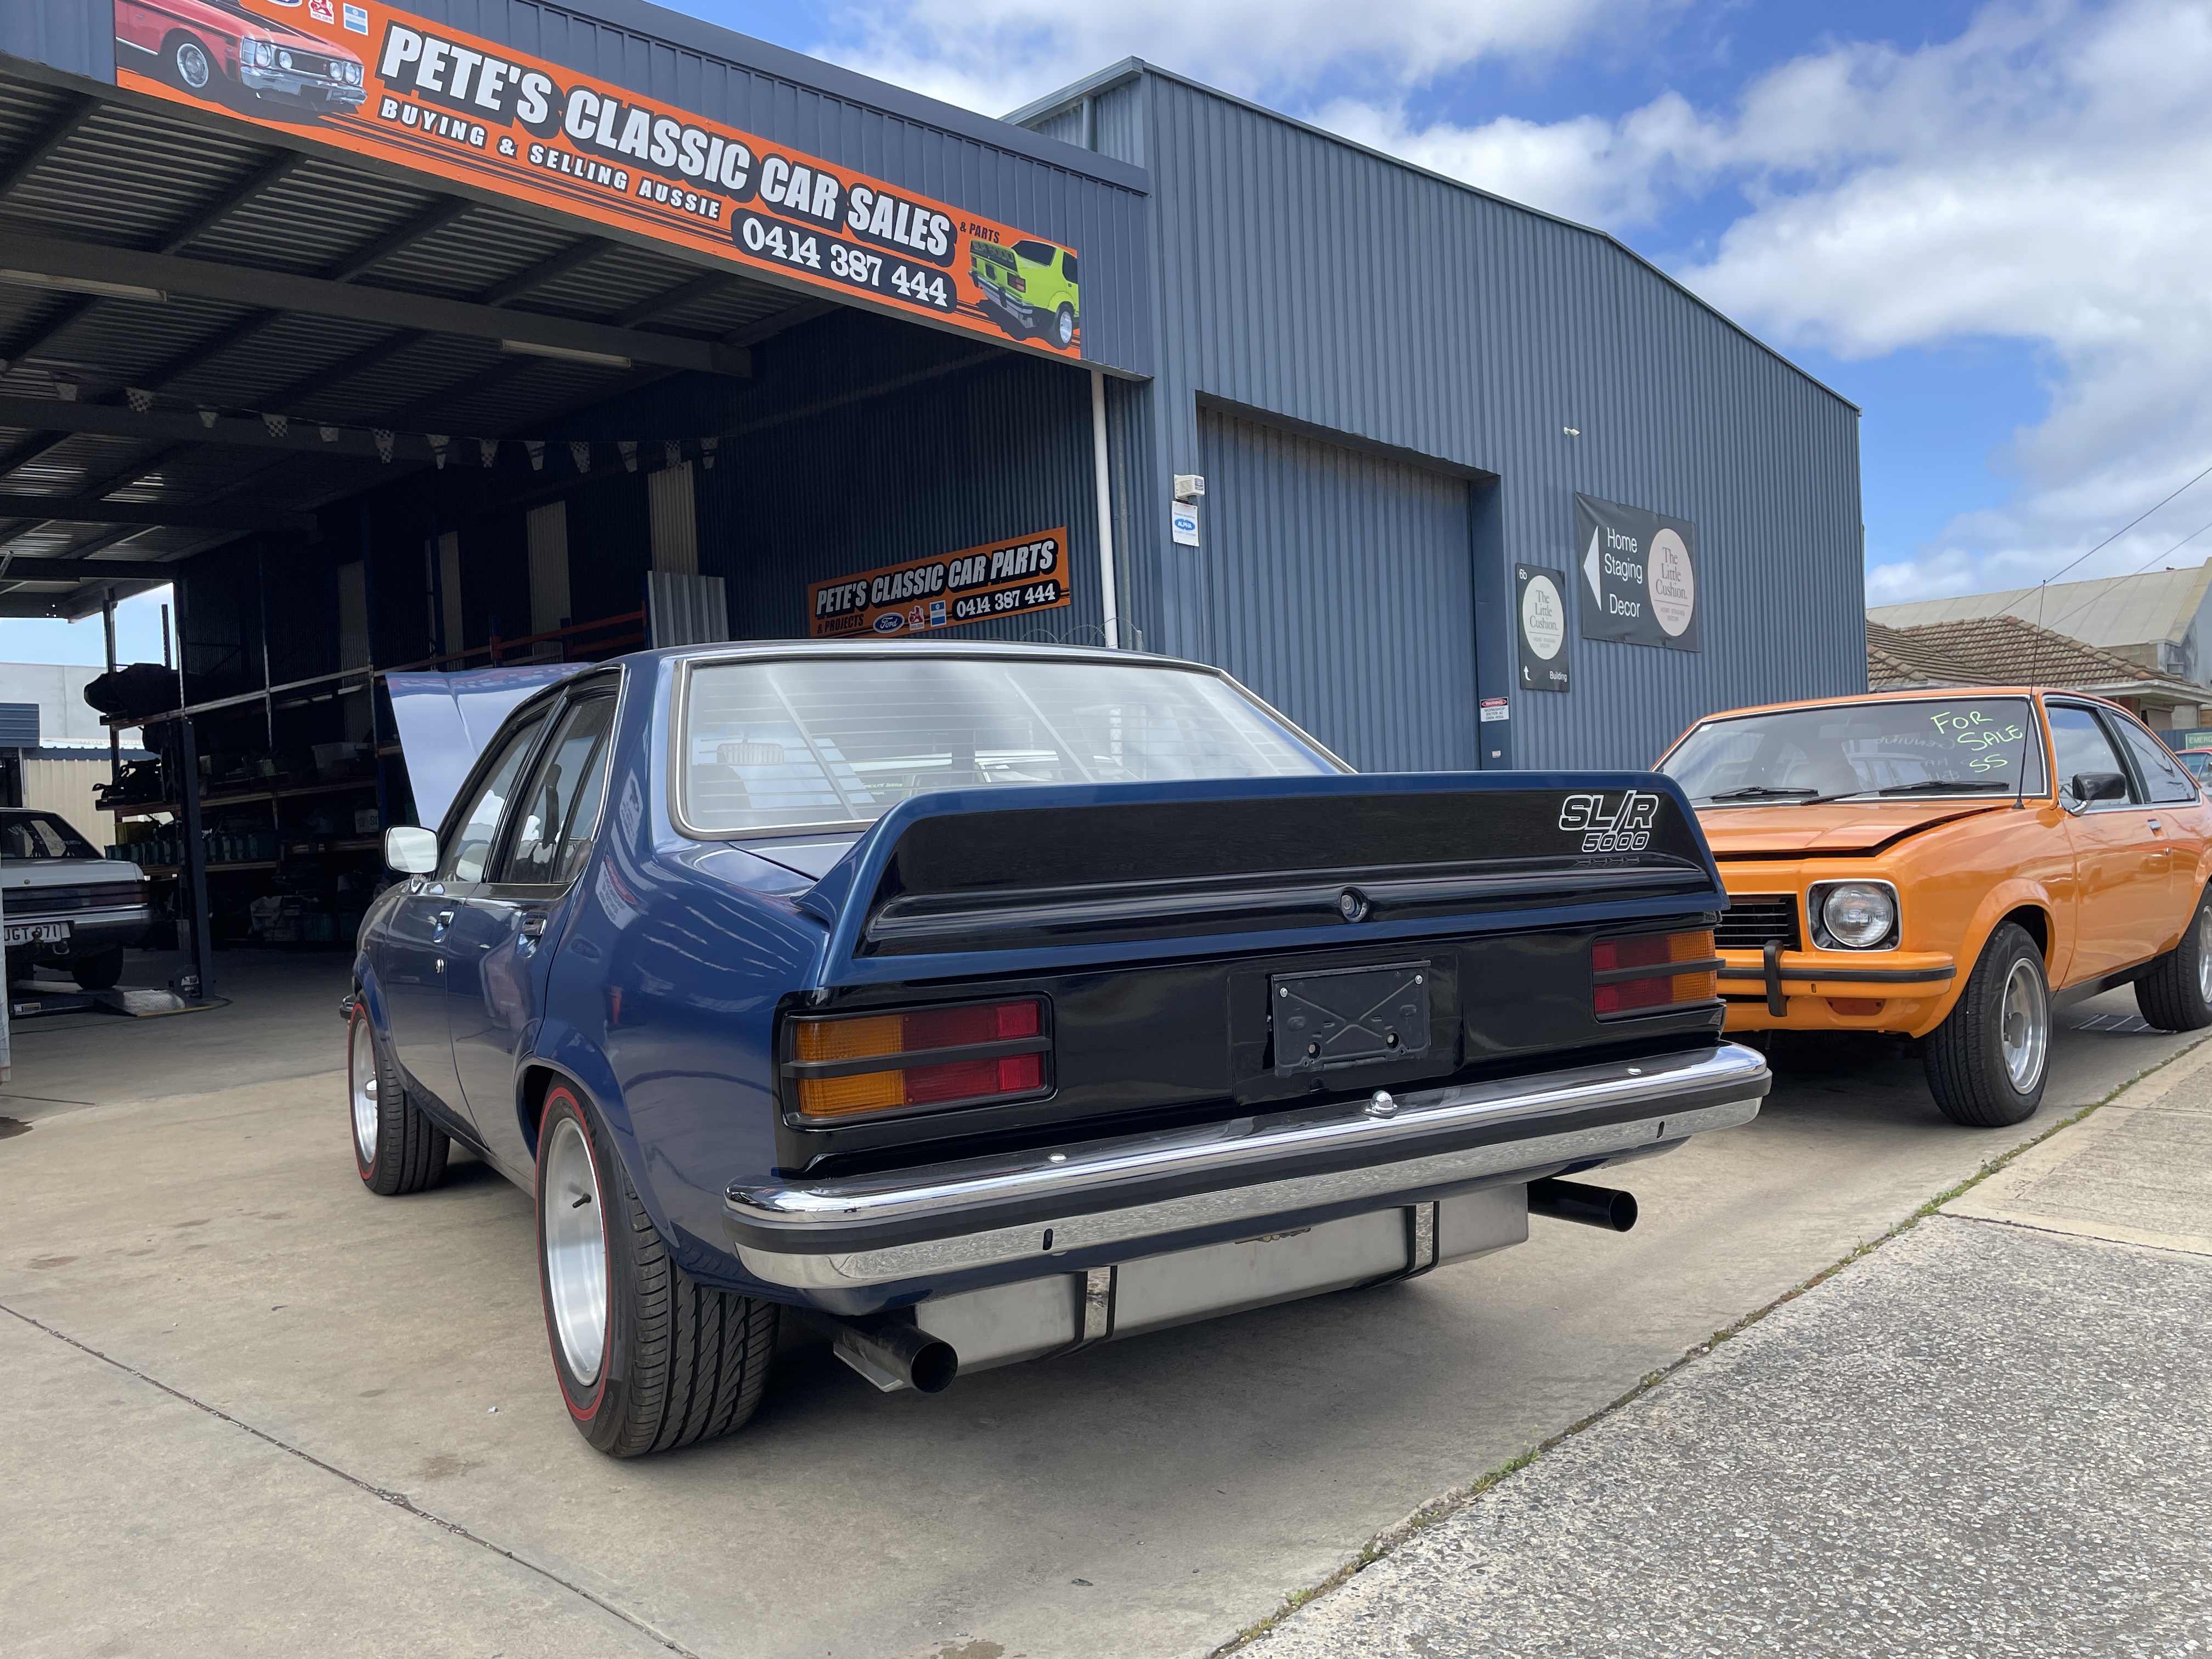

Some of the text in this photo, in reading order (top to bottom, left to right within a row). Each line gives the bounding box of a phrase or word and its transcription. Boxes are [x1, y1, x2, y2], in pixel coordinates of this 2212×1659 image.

[312, 12, 333, 23] HOLDEN
[381, 25, 950, 256] PETE'S CLASSIC CAR SALES
[381, 98, 721, 219] BUYING & SELLING AUSSIE
[960, 222, 1000, 244] & PARTS
[743, 217, 948, 307] 0414 387 444
[1177, 521, 1193, 529] ALPHA
[1607, 527, 1638, 554] Home
[1662, 546, 1678, 565] The
[816, 540, 1054, 616] PETE'S CLASSIC CAR PARTS
[1519, 568, 1527, 580] 6b
[1605, 552, 1643, 584] Staging
[1661, 562, 1681, 583] Little
[956, 583, 1055, 618] 0414 387 444
[1536, 589, 1550, 604] The
[1655, 581, 1688, 600] Cushion.
[1535, 602, 1553, 617] Little
[1610, 594, 1640, 618] Decor
[817, 613, 864, 634] & PROJECTS
[879, 617, 898, 629] Ford
[1530, 615, 1559, 630] Cushion.
[1549, 670, 1567, 682] Building
[1930, 710, 1994, 734] FOR
[1957, 724, 2023, 751] SALE
[1558, 789, 1660, 834] SL/R
[1581, 831, 1650, 853] 5000
